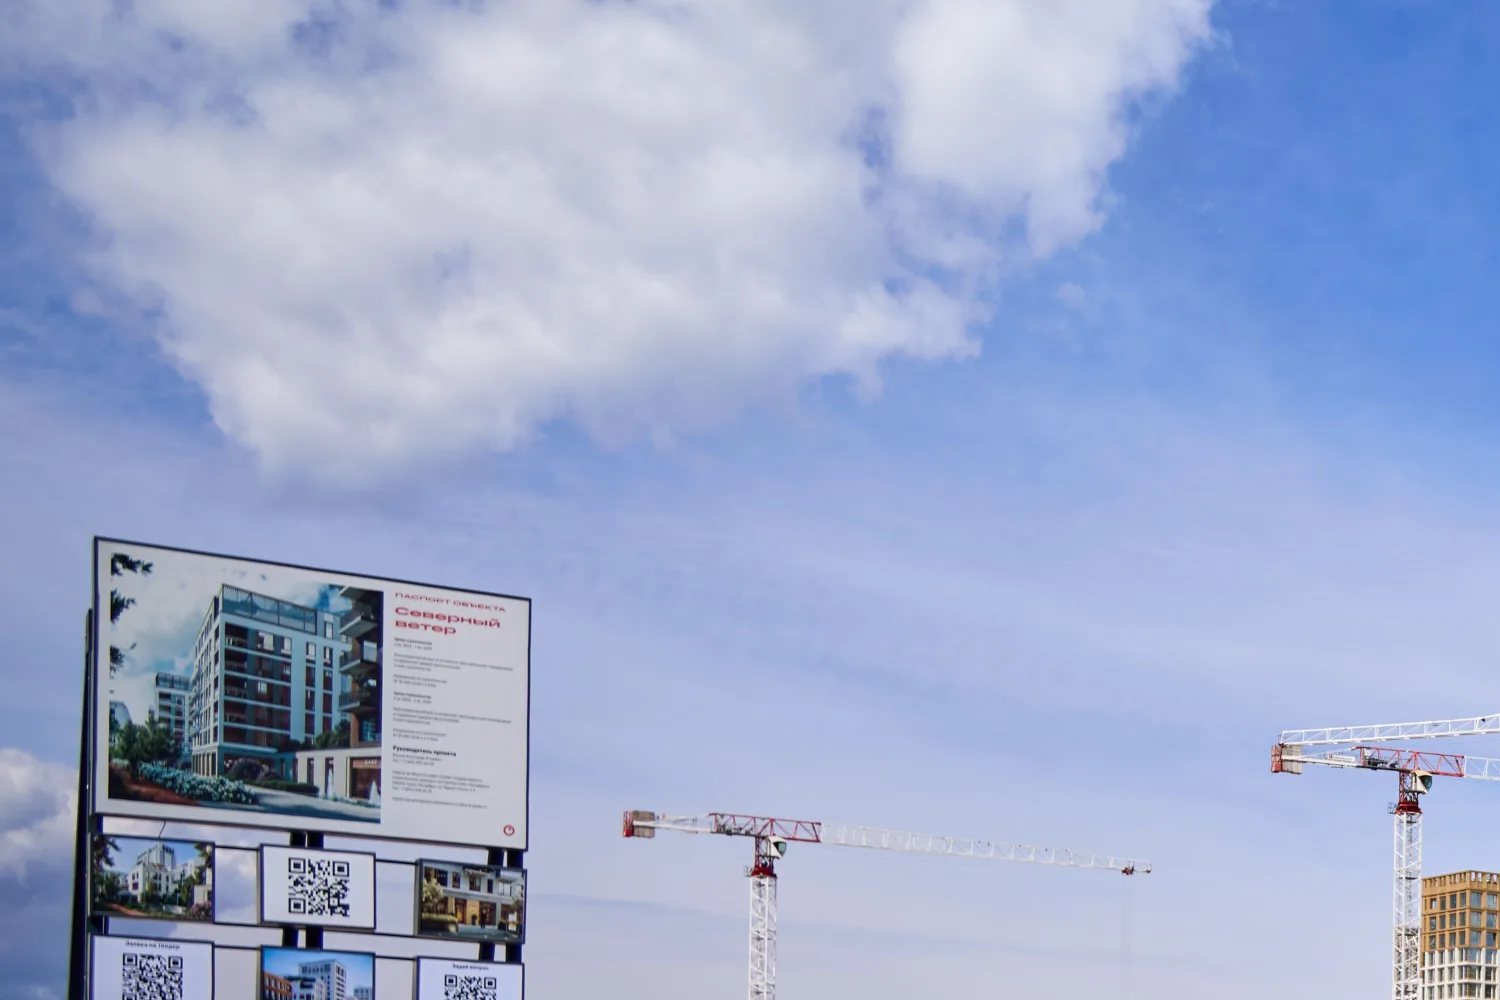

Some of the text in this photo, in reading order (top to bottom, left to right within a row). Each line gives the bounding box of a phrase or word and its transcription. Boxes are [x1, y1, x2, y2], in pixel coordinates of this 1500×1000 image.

[395, 592, 506, 613] ПАСПОРТ ОБЪЕКТА
[395, 606, 501, 629] Северный
[395, 620, 457, 636] ветер
